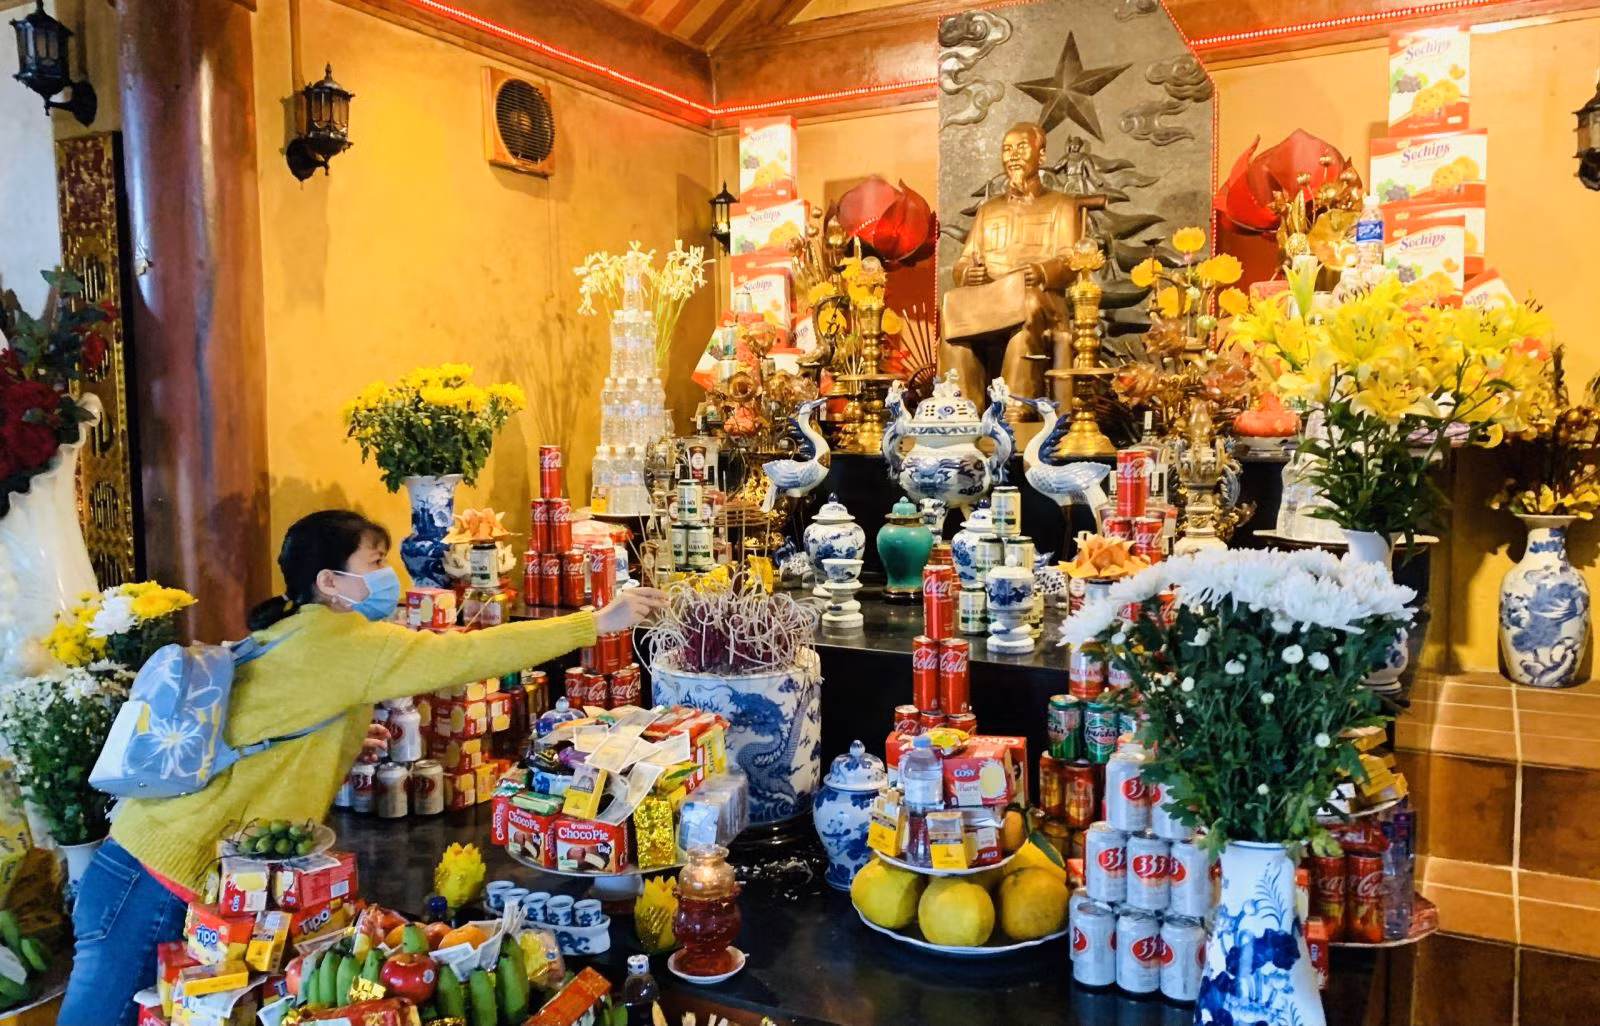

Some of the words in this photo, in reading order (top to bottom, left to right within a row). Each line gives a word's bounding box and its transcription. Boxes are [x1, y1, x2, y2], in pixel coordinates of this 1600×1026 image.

[1401, 142, 1450, 164] Sochips
[1400, 230, 1446, 251] Sochips
[923, 576, 952, 597] Coca
[912, 647, 938, 670] Cola
[939, 650, 968, 673] Cola
[558, 827, 609, 841] ChocoPie
[301, 908, 332, 935] Tipo
[196, 925, 218, 946] Tipo
